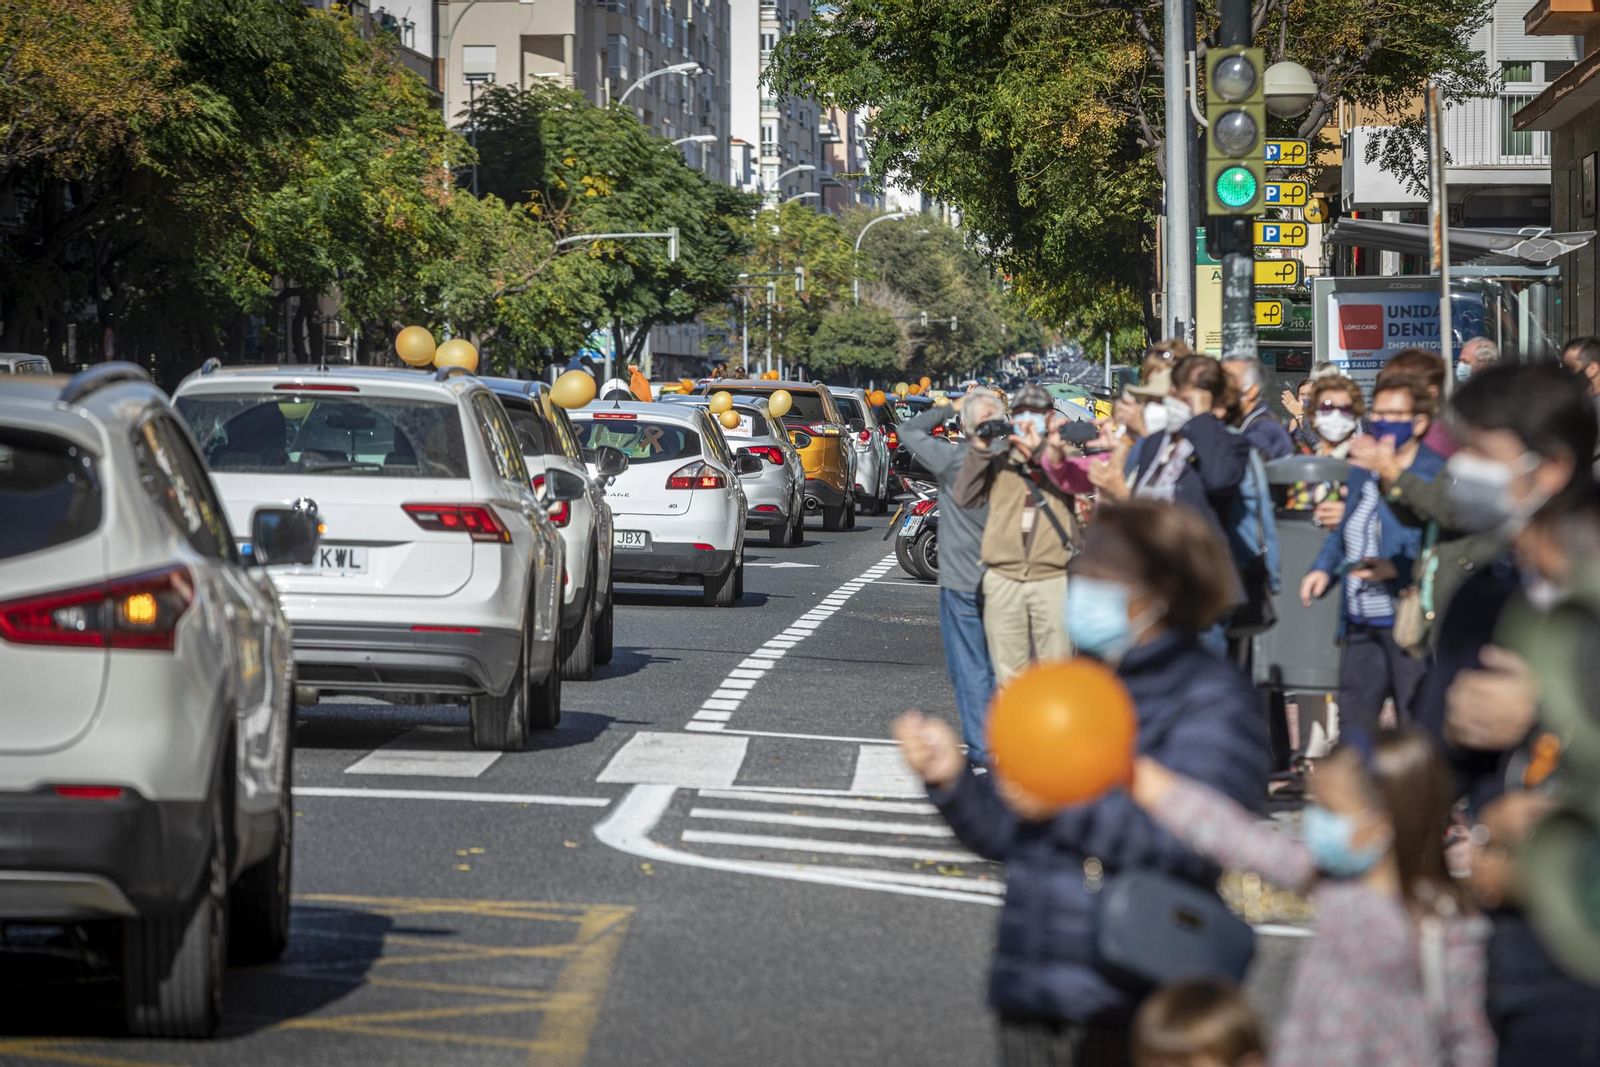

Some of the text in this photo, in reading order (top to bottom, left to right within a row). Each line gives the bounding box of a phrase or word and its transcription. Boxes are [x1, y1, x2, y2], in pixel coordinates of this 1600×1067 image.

[1266, 145, 1278, 160] P
[1266, 186, 1277, 201] P
[1266, 227, 1277, 241] P
[1388, 282, 1422, 290] JCDecaux
[1351, 351, 1374, 359] Dental
[1340, 361, 1350, 369] LA
[617, 532, 642, 544] JBX
[320, 548, 361, 569] KWL
